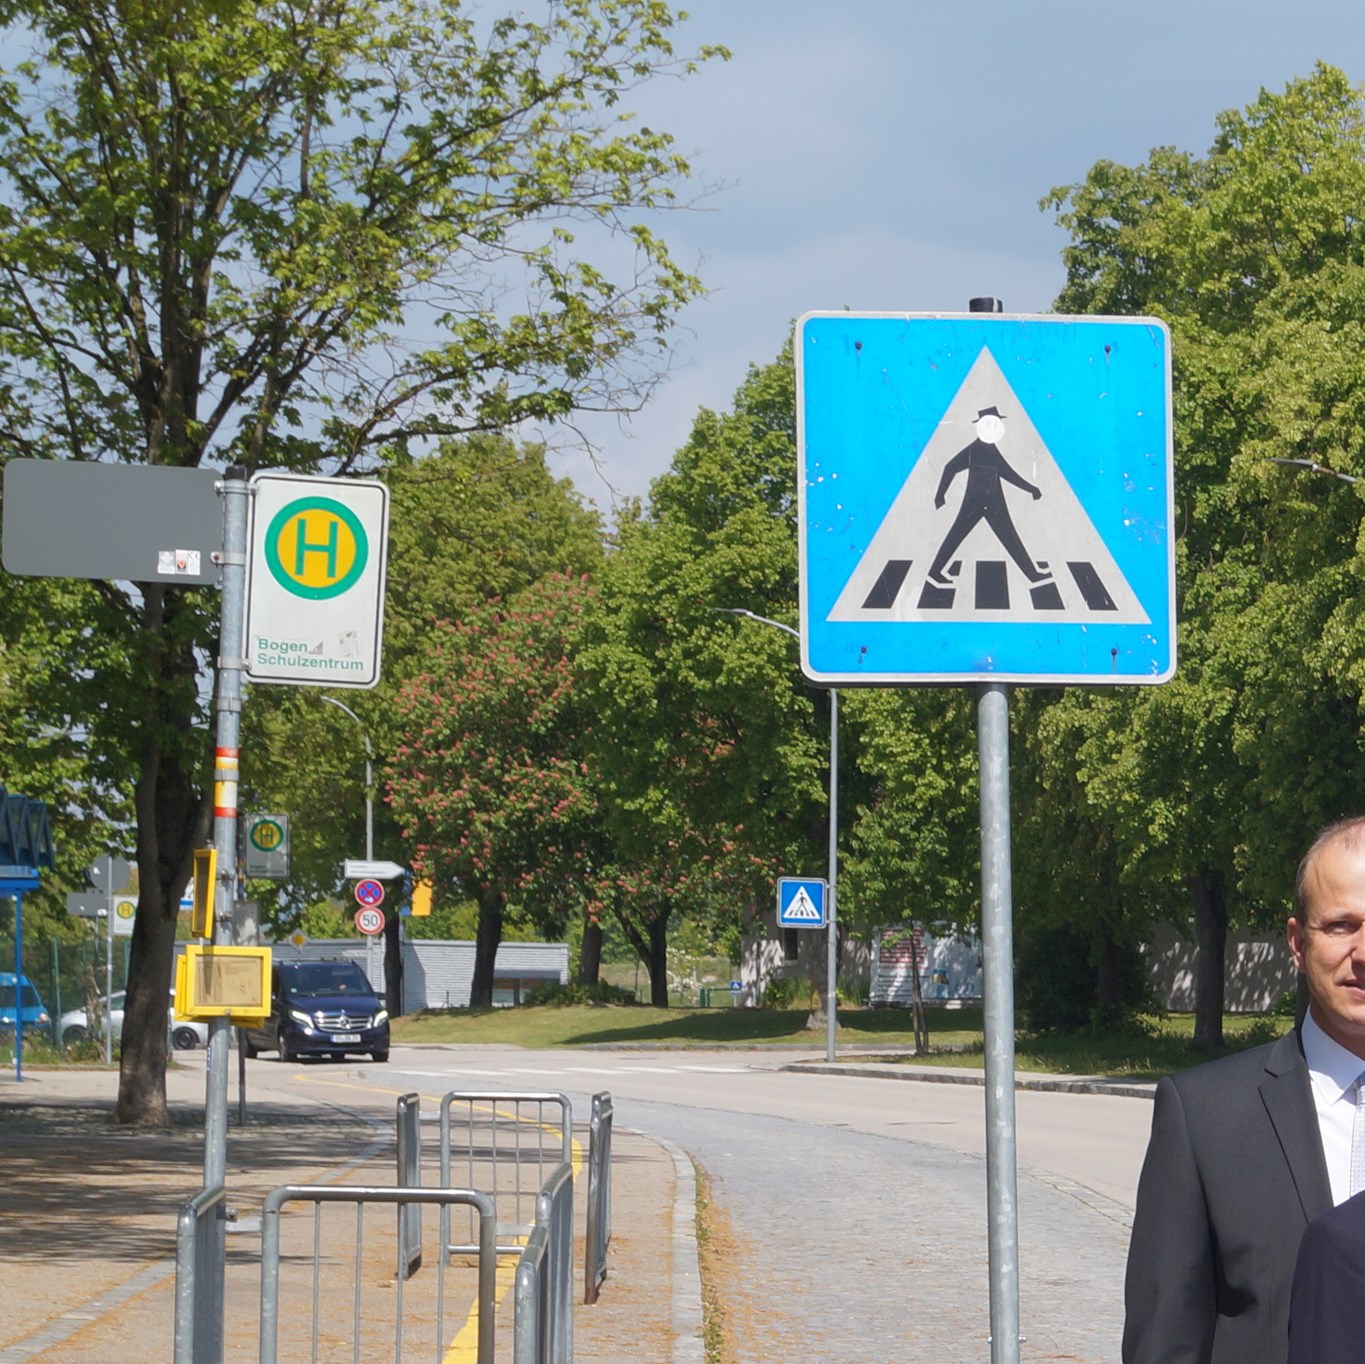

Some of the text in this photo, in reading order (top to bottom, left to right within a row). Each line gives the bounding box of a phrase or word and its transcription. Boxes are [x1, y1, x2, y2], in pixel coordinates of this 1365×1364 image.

[295, 518, 339, 579] H
[257, 638, 308, 654] Bogen
[257, 653, 364, 671] Schulzentrum
[362, 914, 379, 927] 50
